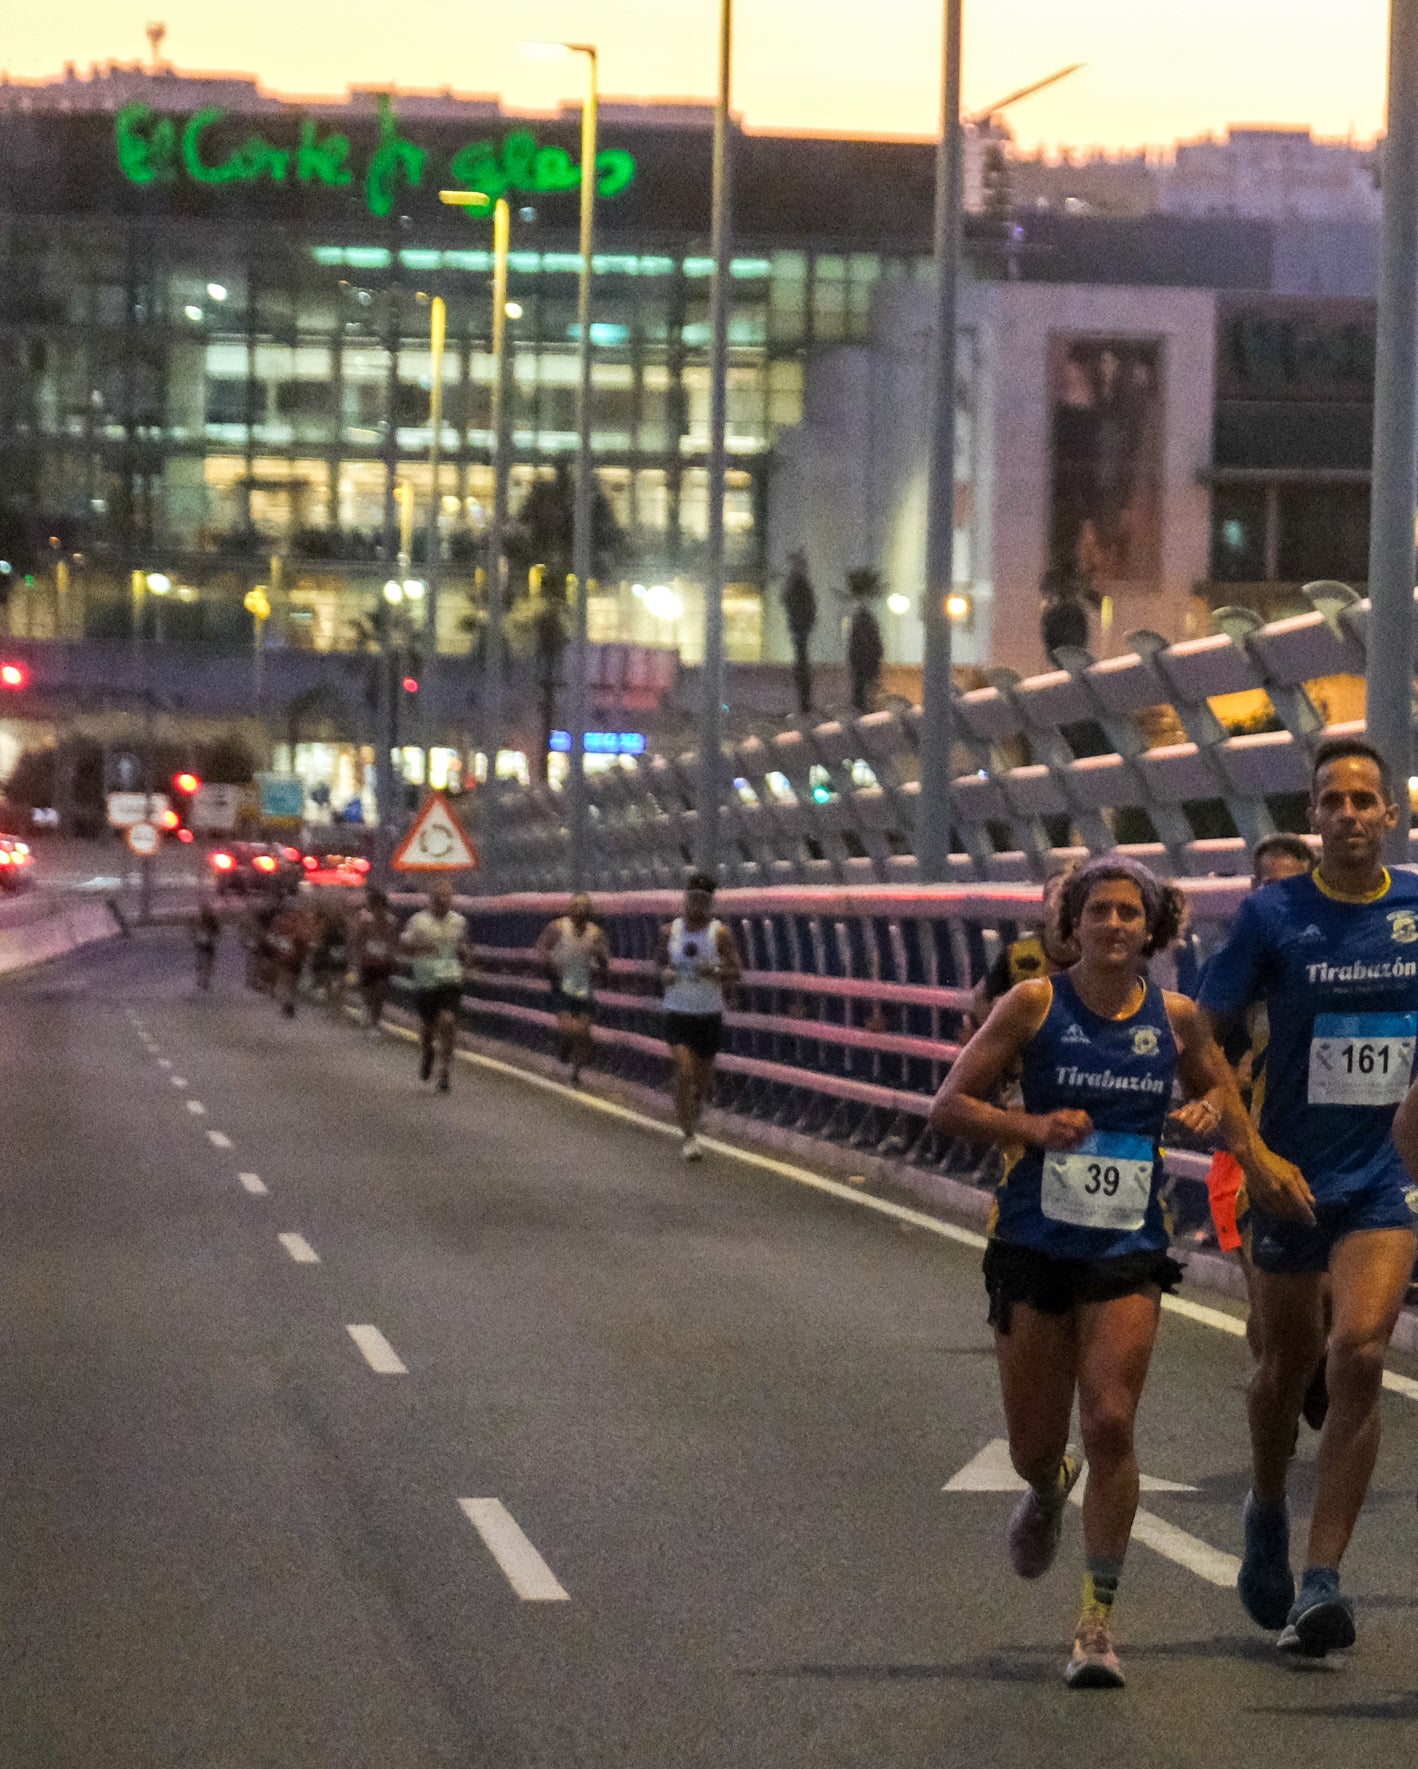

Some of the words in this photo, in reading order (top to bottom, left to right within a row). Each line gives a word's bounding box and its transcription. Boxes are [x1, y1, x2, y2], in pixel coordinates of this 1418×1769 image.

[1305, 956, 1417, 983] Tirabuzón
[1342, 1044, 1389, 1074] 161
[1055, 1065, 1164, 1094] Tirabuzón
[1085, 1163, 1120, 1196] 39
